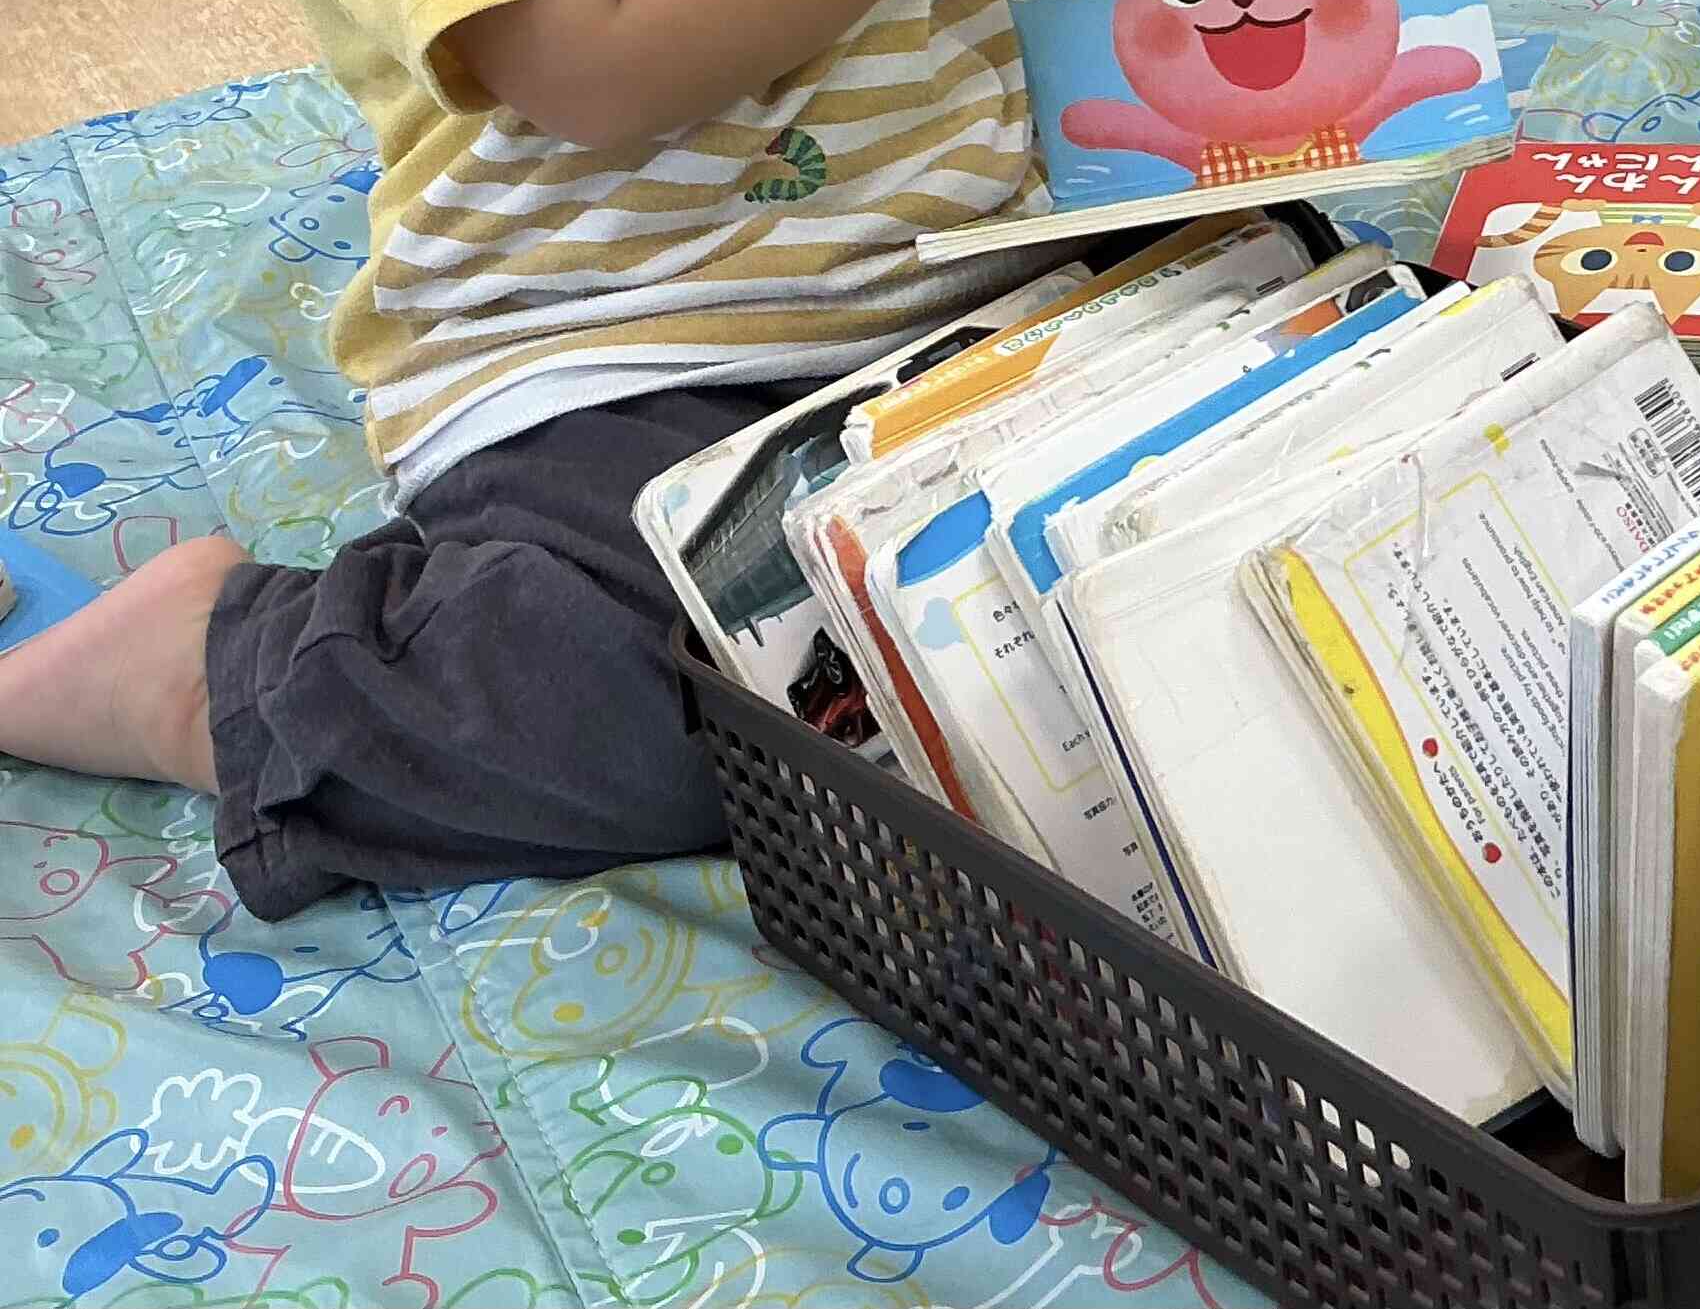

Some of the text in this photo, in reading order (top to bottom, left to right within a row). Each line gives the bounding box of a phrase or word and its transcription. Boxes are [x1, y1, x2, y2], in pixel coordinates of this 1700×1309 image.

[1615, 505, 1651, 554] DAISO
[1517, 576, 1533, 599] how
[1534, 580, 1565, 626] American
[1531, 597, 1548, 625] help
[994, 629, 1036, 660] それぞれ
[1499, 620, 1526, 660] discover
[1500, 646, 1525, 685] picture
[1545, 668, 1565, 698] these
[1531, 697, 1551, 726] foods
[1535, 681, 1565, 724] together
[1432, 761, 1484, 843] おうちのかたへ
[1449, 765, 1476, 805] parents
